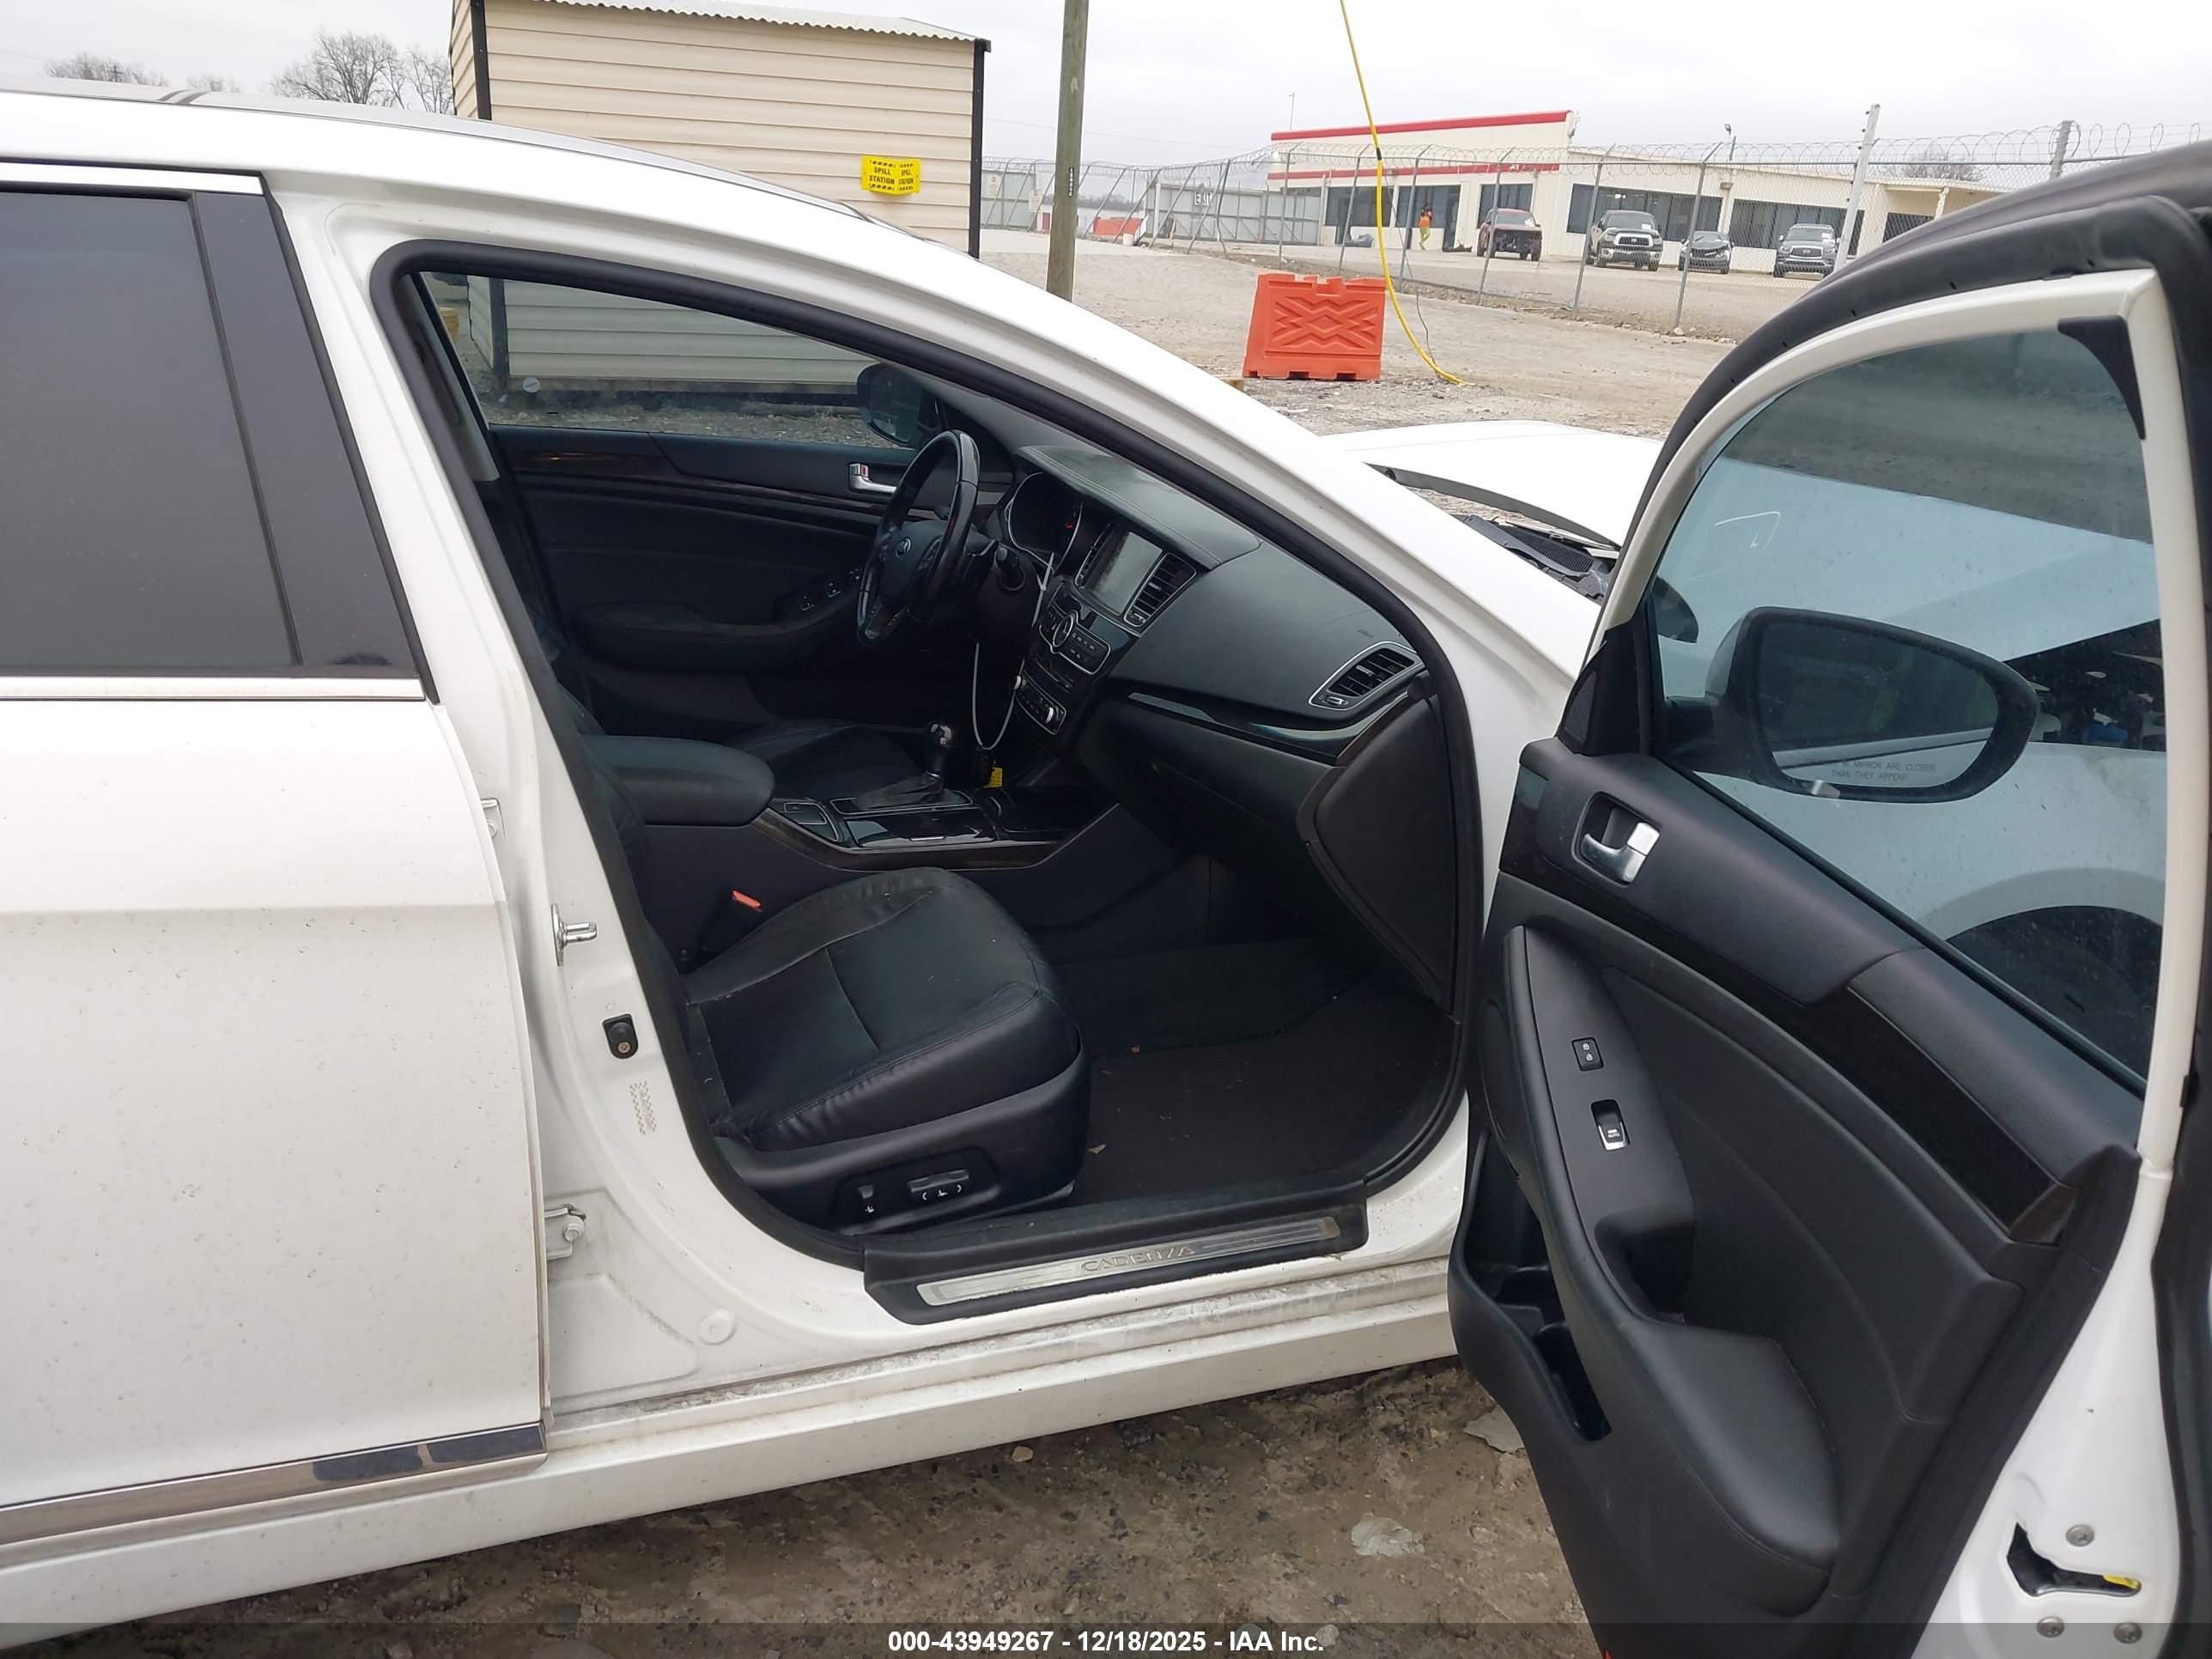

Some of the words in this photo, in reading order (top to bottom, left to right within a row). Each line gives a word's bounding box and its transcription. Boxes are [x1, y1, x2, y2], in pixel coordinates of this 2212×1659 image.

[874, 167, 891, 175] SPILL
[869, 175, 895, 185] STATION
[1195, 191, 1212, 205] EXIT
[1081, 1245, 1195, 1272] CADENZA
